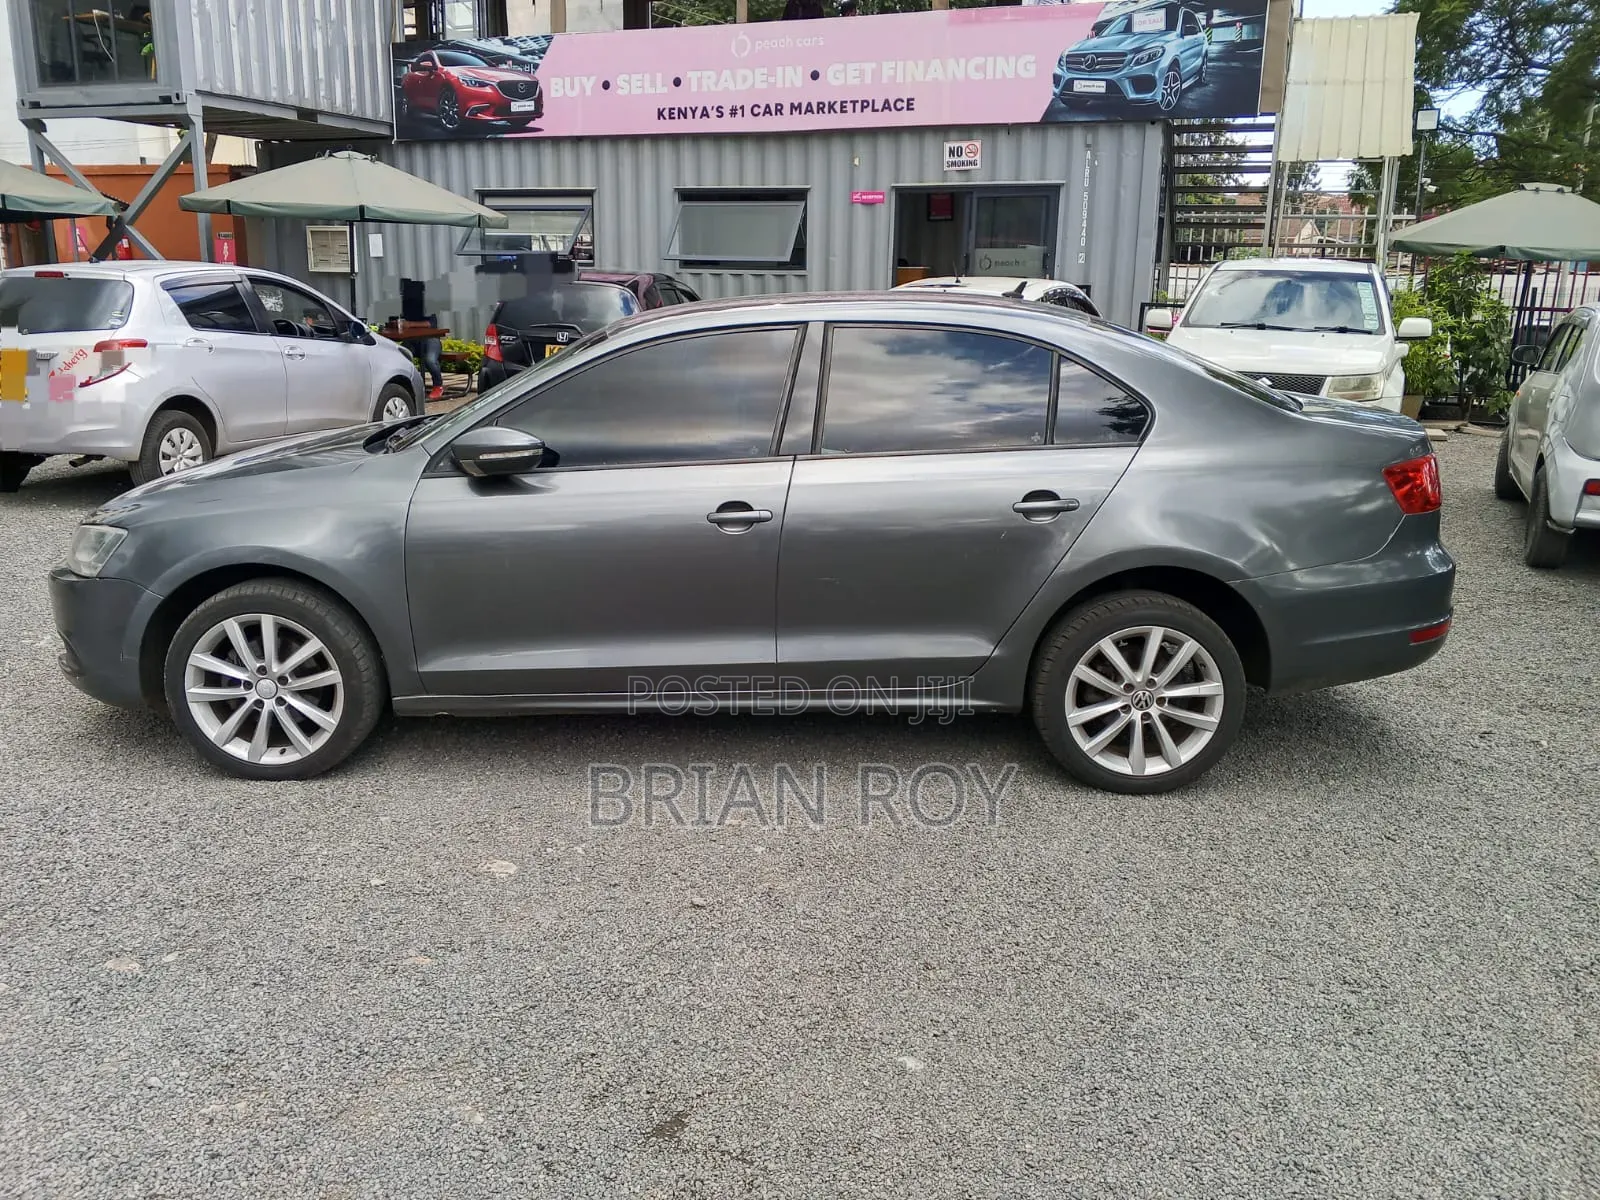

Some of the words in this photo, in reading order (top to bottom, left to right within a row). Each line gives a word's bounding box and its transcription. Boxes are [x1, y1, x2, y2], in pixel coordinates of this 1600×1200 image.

[755, 35, 794, 53] peach
[796, 35, 825, 47] cars
[549, 76, 596, 98] BUY
[616, 72, 668, 96] SELL
[686, 65, 803, 92] TRADE-IN
[826, 61, 877, 87] GET
[880, 54, 1037, 84] FINANCING
[656, 105, 725, 121] KENYA'S
[728, 105, 745, 118] #1
[750, 102, 784, 118] CAR
[789, 97, 915, 116] MARKETPLACE
[948, 145, 963, 158] NO
[946, 159, 978, 168] SMOKING
